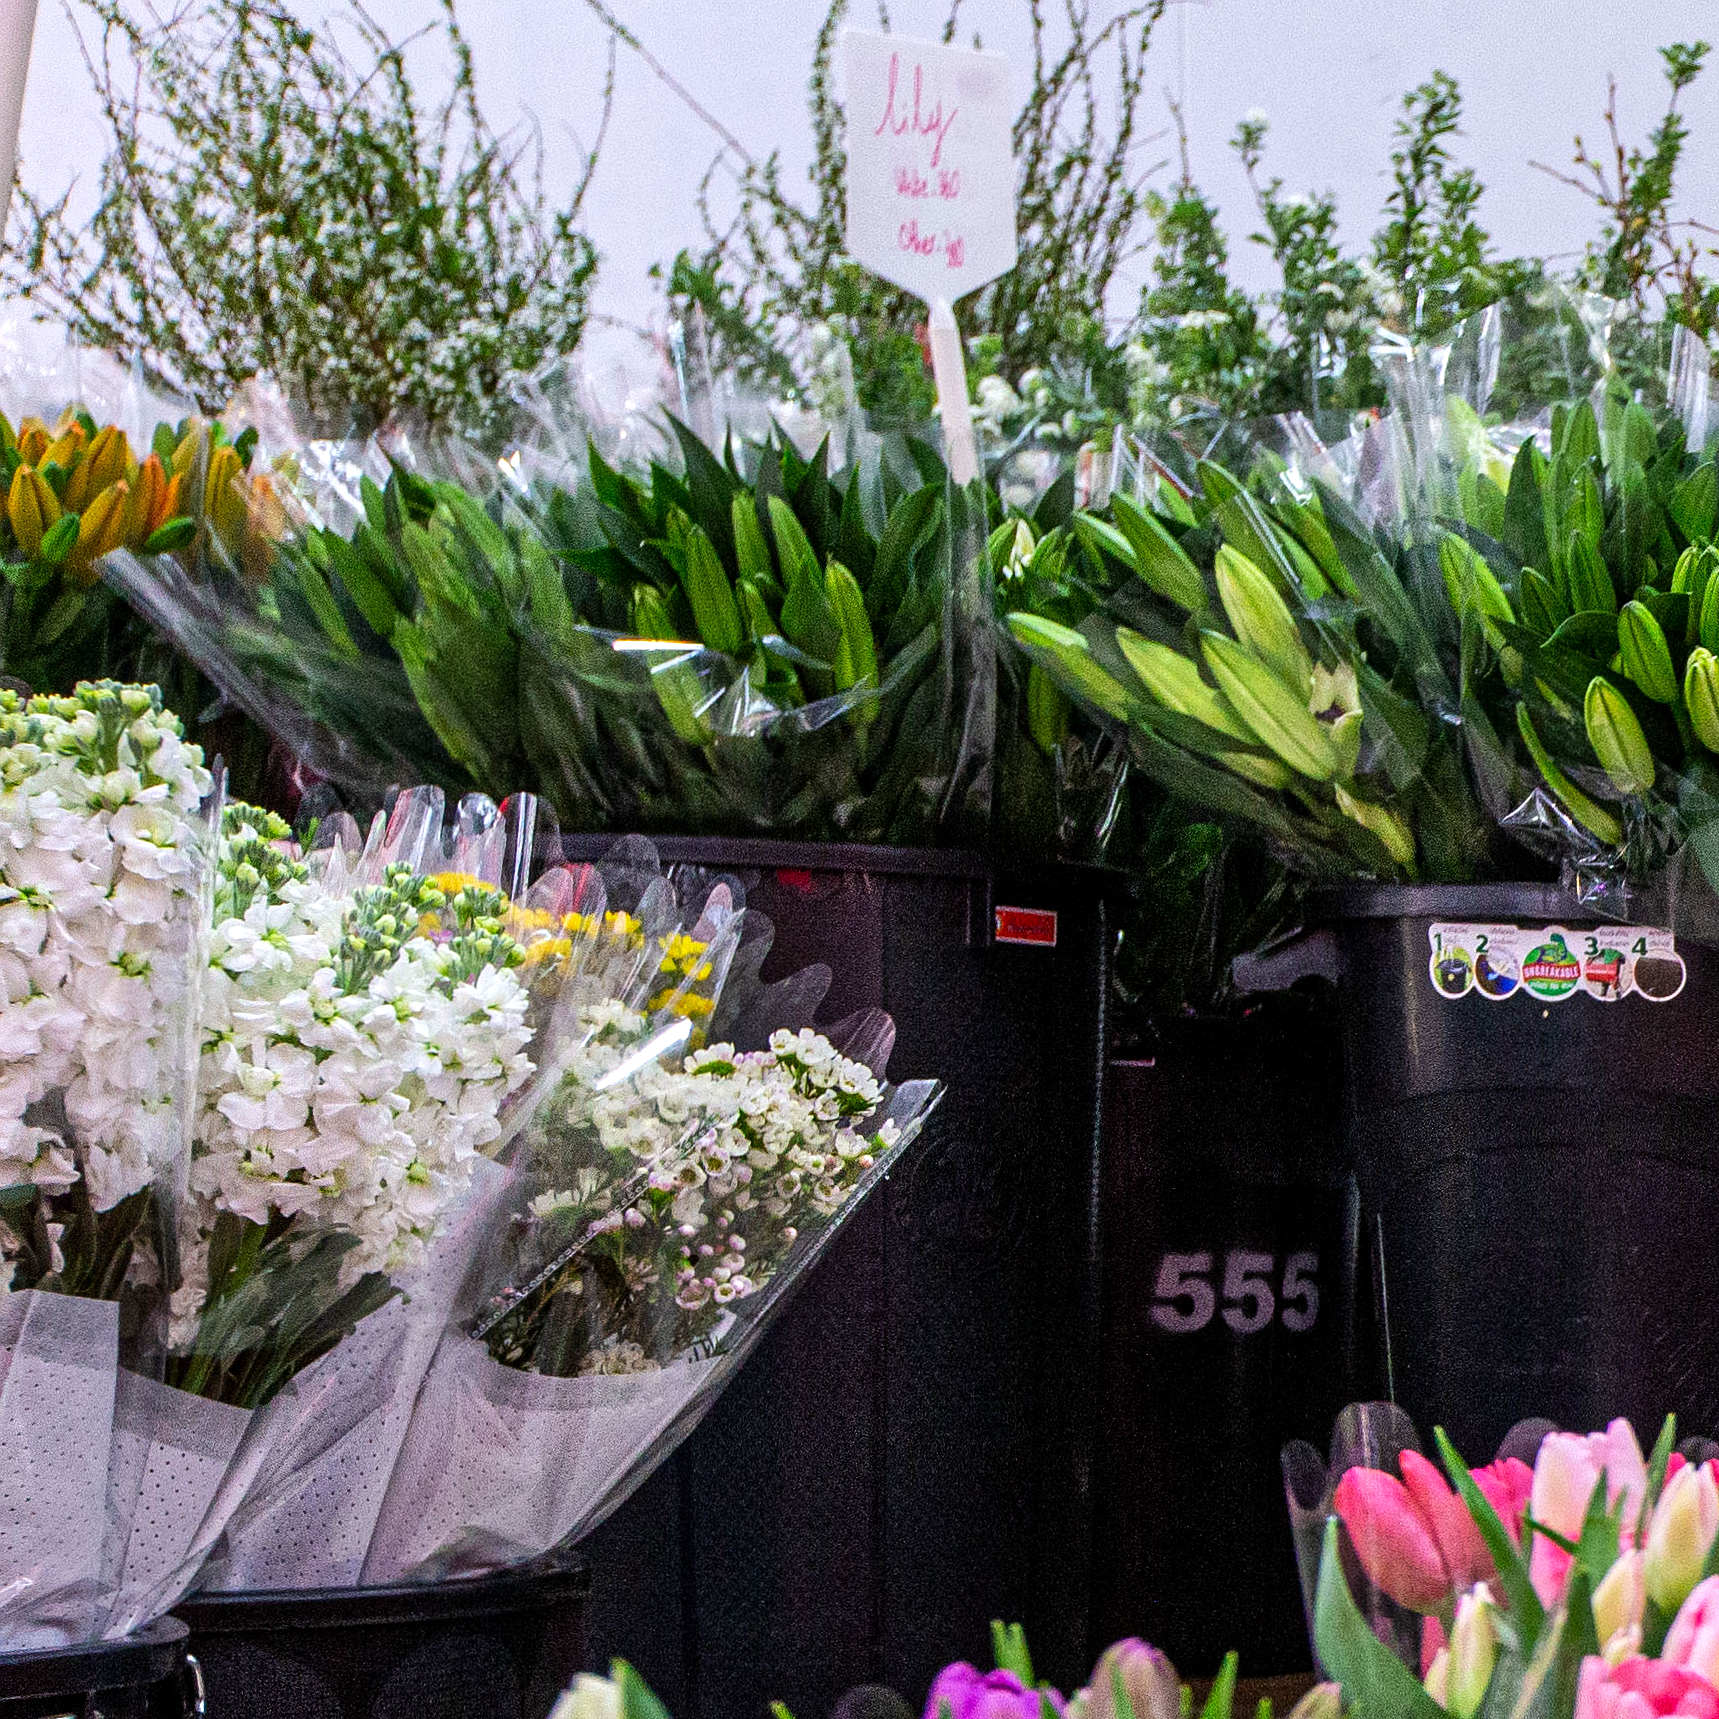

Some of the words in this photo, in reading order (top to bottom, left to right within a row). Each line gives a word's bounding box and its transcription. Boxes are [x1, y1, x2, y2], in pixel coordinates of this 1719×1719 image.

[1433, 932, 1442, 952] 1
[1475, 934, 1489, 954] 2
[1583, 936, 1599, 956] 3
[1631, 936, 1649, 956] 4
[1149, 1251, 1320, 1334] 555
